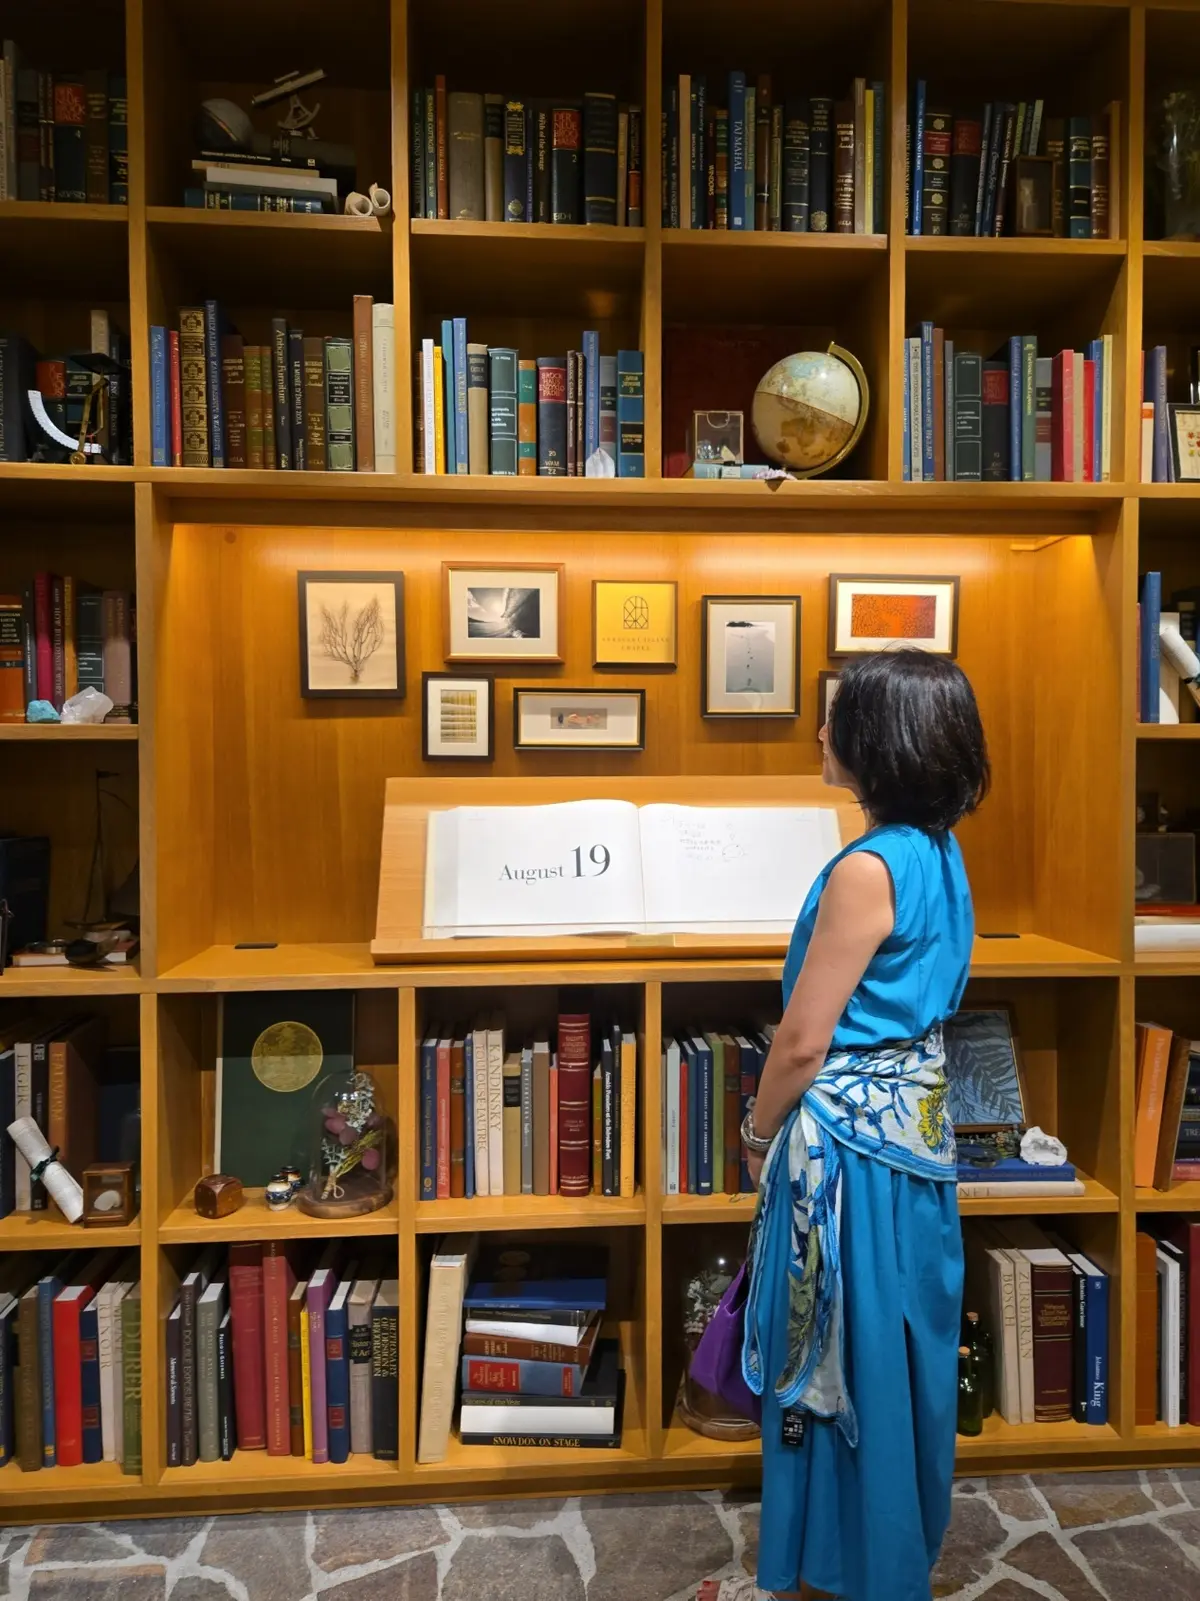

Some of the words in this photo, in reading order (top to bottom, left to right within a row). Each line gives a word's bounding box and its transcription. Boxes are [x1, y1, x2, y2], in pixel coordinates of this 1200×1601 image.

[572, 154, 577, 163] 2
[734, 136, 742, 172] MAHAL
[275, 330, 286, 364] Antique
[278, 365, 287, 404] Furniture
[56, 404, 63, 412] 3
[54, 608, 62, 626] HOW
[499, 864, 564, 885] August
[571, 844, 610, 878] 19
[52, 1052, 64, 1122] FAUVISM
[476, 1044, 487, 1154] TOULOUSE-LAUTREC
[488, 1044, 501, 1131] KANDINSKY
[1003, 1274, 1016, 1327] BOSCH
[100, 1304, 112, 1370] RENOIR
[381, 1317, 388, 1330] OF
[183, 1330, 192, 1364] DOUBLE
[373, 1318, 381, 1377] DECORATION
[380, 1332, 388, 1368] DESIGN
[381, 1370, 388, 1378] &
[1090, 1381, 1104, 1408] King
[492, 1436, 538, 1445] SNOWDON
[539, 1438, 552, 1446] ON
[554, 1438, 580, 1446] STAGE
